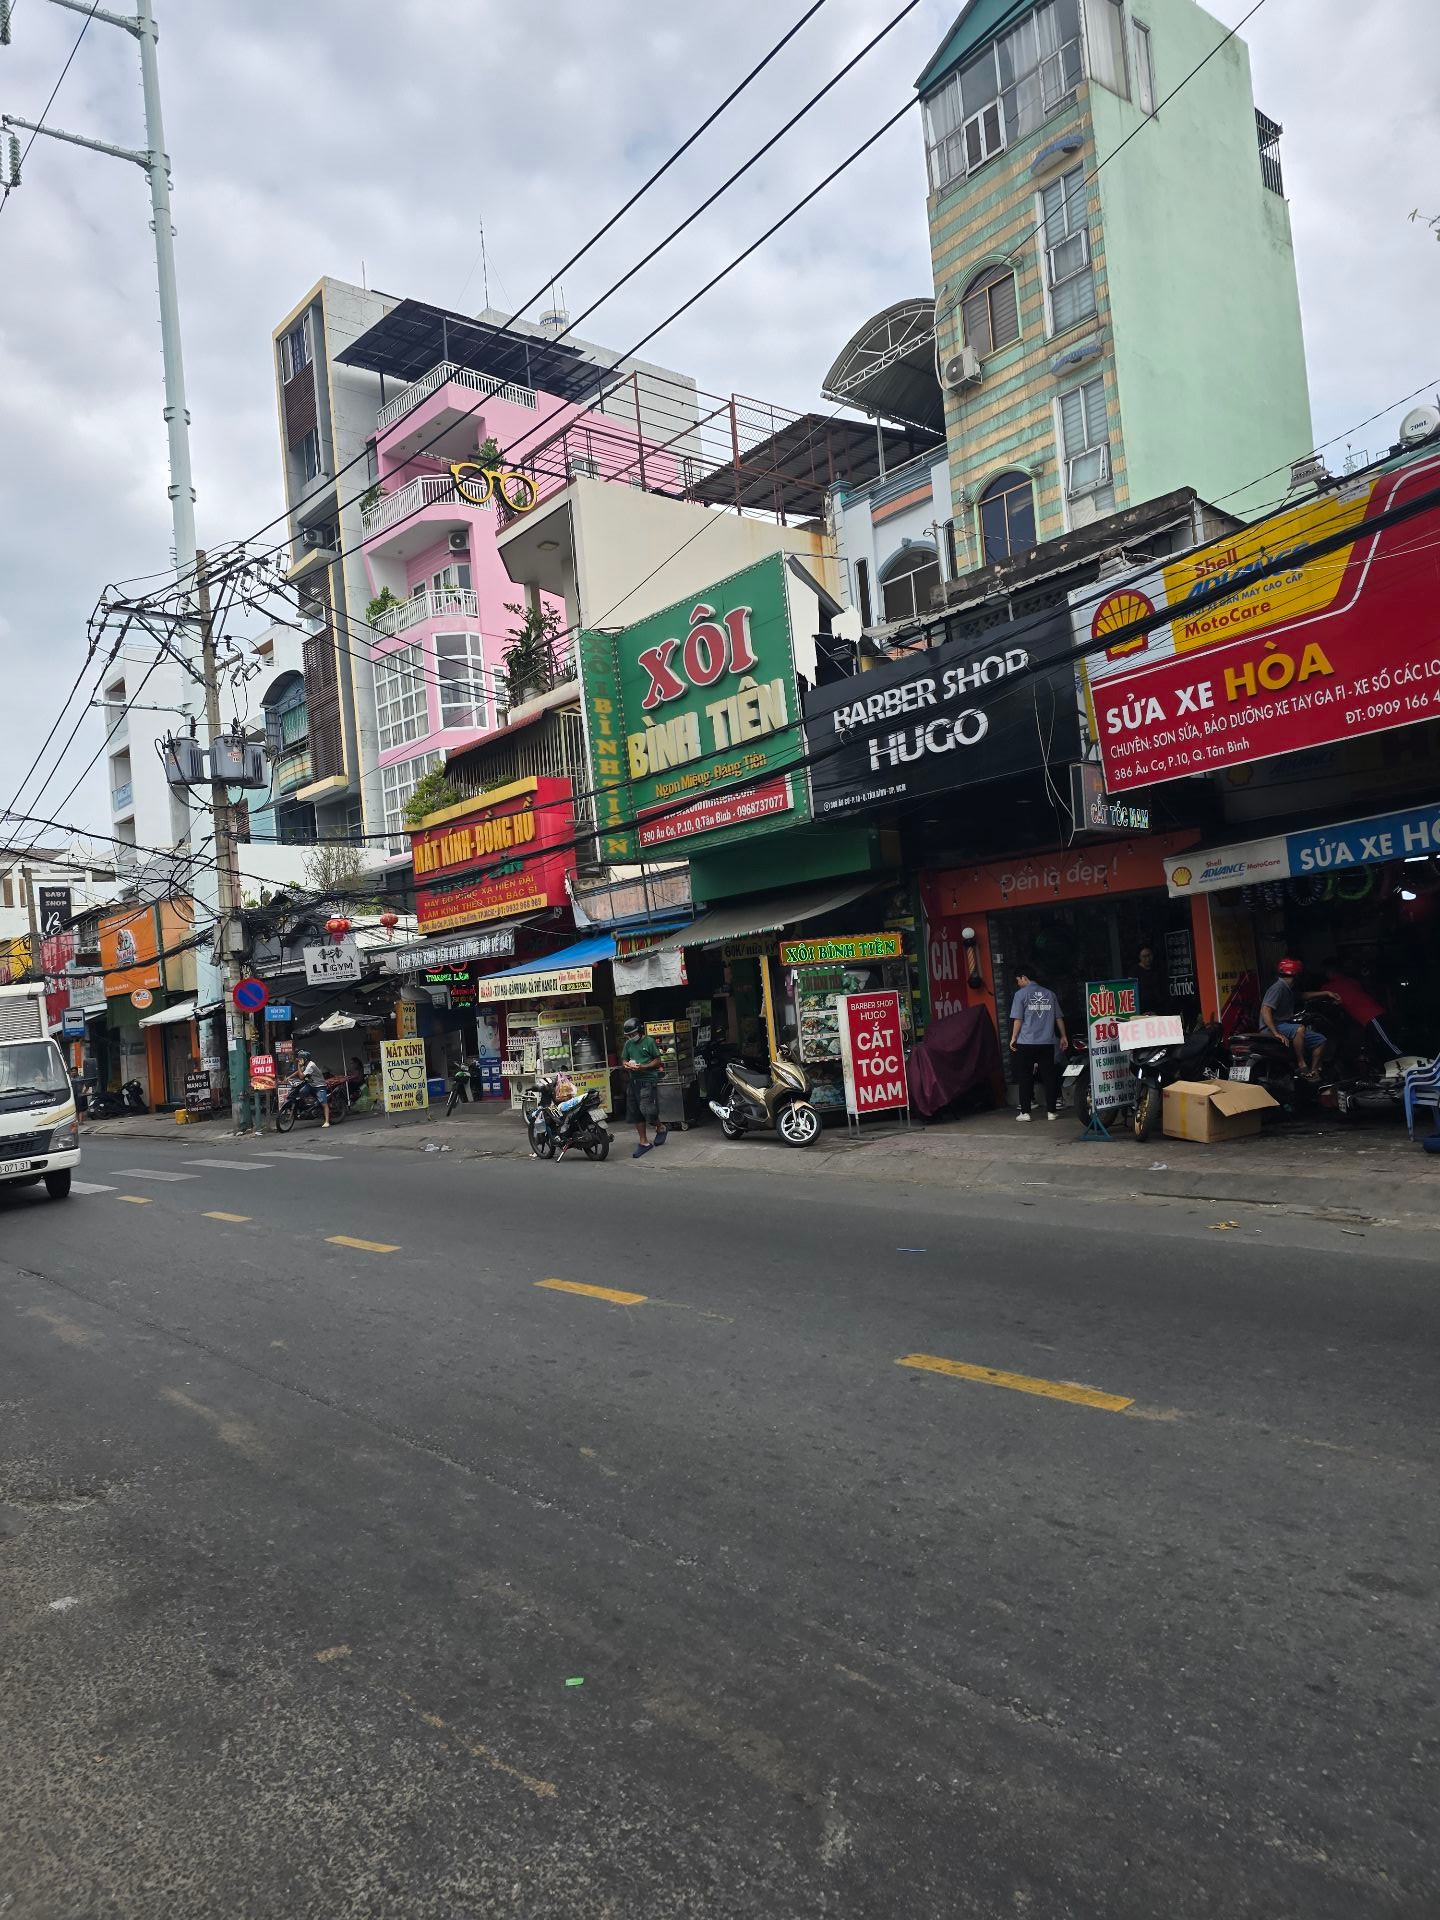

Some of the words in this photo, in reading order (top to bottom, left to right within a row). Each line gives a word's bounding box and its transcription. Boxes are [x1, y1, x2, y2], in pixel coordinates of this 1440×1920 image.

[1194, 547, 1238, 578] Shell
[1241, 586, 1261, 600] MÁY
[1262, 580, 1283, 592] CAO
[1285, 572, 1304, 584] CẤP
[1184, 601, 1272, 638] MotoCare
[637, 603, 759, 710] XÔI
[1106, 693, 1167, 734] SỬA
[1174, 681, 1216, 717] XE
[1223, 640, 1335, 702] HÒA
[832, 678, 938, 733] BARBER
[1110, 736, 1152, 759] CHUYÊN:
[1153, 729, 1176, 748] SƠN
[1178, 721, 1203, 742] SỬA,
[1204, 713, 1228, 735] BẢO
[1229, 704, 1274, 728] DƯỠNG
[1274, 699, 1290, 717] XE
[1290, 694, 1313, 712] TAY
[1314, 688, 1334, 706] GA
[1335, 684, 1346, 700] FI
[1353, 679, 1370, 696] XE
[1372, 667, 1391, 692] SỐ
[1394, 663, 1423, 685] CÁC
[1345, 708, 1366, 724] ĐT:
[1367, 699, 1401, 719] 0909
[1404, 692, 1429, 710] 166
[627, 711, 702, 780] BÌNH
[867, 708, 989, 771] HUGO
[1114, 767, 1133, 781] 386
[1135, 760, 1149, 776] Âu
[1150, 758, 1167, 772] Cơ,
[1168, 752, 1190, 768] P.10,
[1192, 749, 1206, 761] Q.
[1206, 745, 1225, 758] Tân
[1227, 736, 1250, 753] Bình
[655, 782, 681, 799] Ngon
[642, 831, 656, 844] 390
[656, 825, 665, 838] Âu
[677, 821, 695, 835] P.10,
[716, 811, 731, 824] Bình
[736, 794, 785, 818] 0968737077
[1090, 793, 1108, 825] CẮT
[1109, 800, 1129, 827] TÓC
[413, 831, 441, 875] MẮT
[441, 828, 473, 866] KÍNH
[475, 809, 513, 857] ĐỒNG
[512, 795, 536, 844] HỒ
[1205, 858, 1222, 869] Shell
[1299, 838, 1355, 871] SỬA
[1359, 833, 1394, 860] XE
[1199, 861, 1246, 880] ADVANCE
[1246, 859, 1281, 870] MotoCare
[785, 942, 815, 962] XÔI
[817, 940, 856, 961] BÌNH
[931, 926, 959, 982] CẮT
[312, 962, 329, 974] LT
[329, 962, 354, 972] GYM
[850, 1001, 876, 1011] BARBER
[876, 999, 894, 1008] SHOP
[860, 1010, 887, 1021] HUGO
[1089, 984, 1116, 1017] SỬA
[1118, 989, 1136, 1014] XE
[857, 1021, 894, 1051] CẮT
[1095, 1018, 1119, 1041] HÒ
[385, 1043, 403, 1059] MẮT
[404, 1042, 424, 1057] KÍNH
[387, 1059, 410, 1068] THANH
[857, 1051, 899, 1078] TÓC
[1102, 1069, 1116, 1081] TEST
[859, 1081, 903, 1105] NAM
